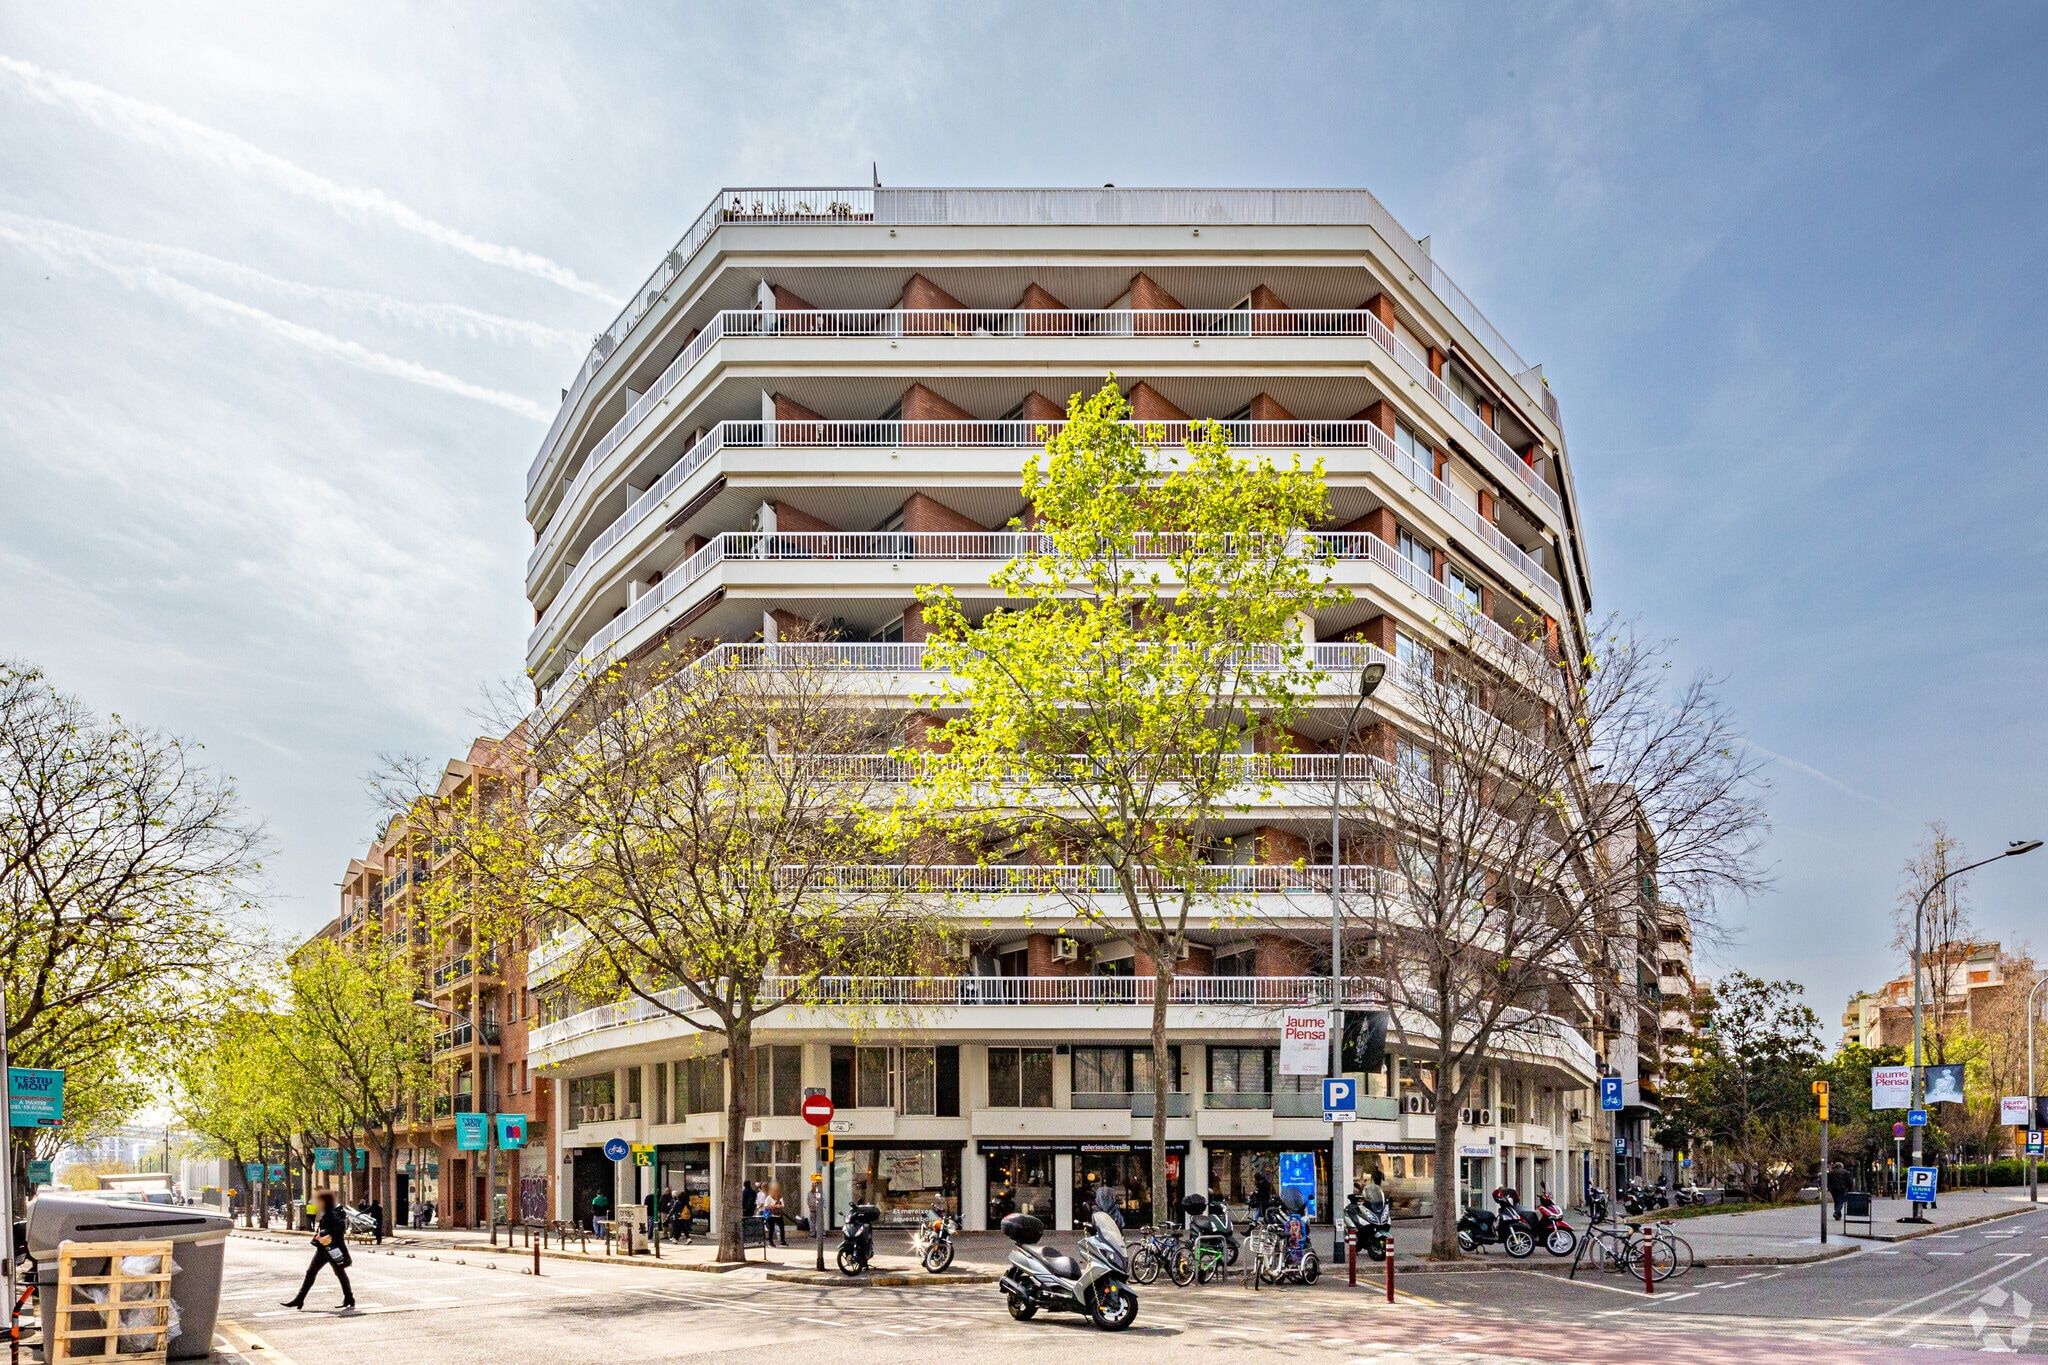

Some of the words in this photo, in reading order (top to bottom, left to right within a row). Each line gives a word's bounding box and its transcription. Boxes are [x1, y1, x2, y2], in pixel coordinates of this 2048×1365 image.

[1285, 1015, 1325, 1028] Jaume
[1285, 1028, 1326, 1040] Plensa
[13, 1076, 53, 1084] T'ESTIU
[1875, 1071, 1908, 1079] Jaume
[17, 1083, 49, 1091] MOLT
[1606, 1082, 1617, 1095] P
[1875, 1079, 1909, 1087] Plensa
[1329, 1082, 1350, 1108] P
[1616, 1139, 1623, 1147] P
[2030, 1132, 2040, 1144] P
[1915, 1172, 1929, 1185] P
